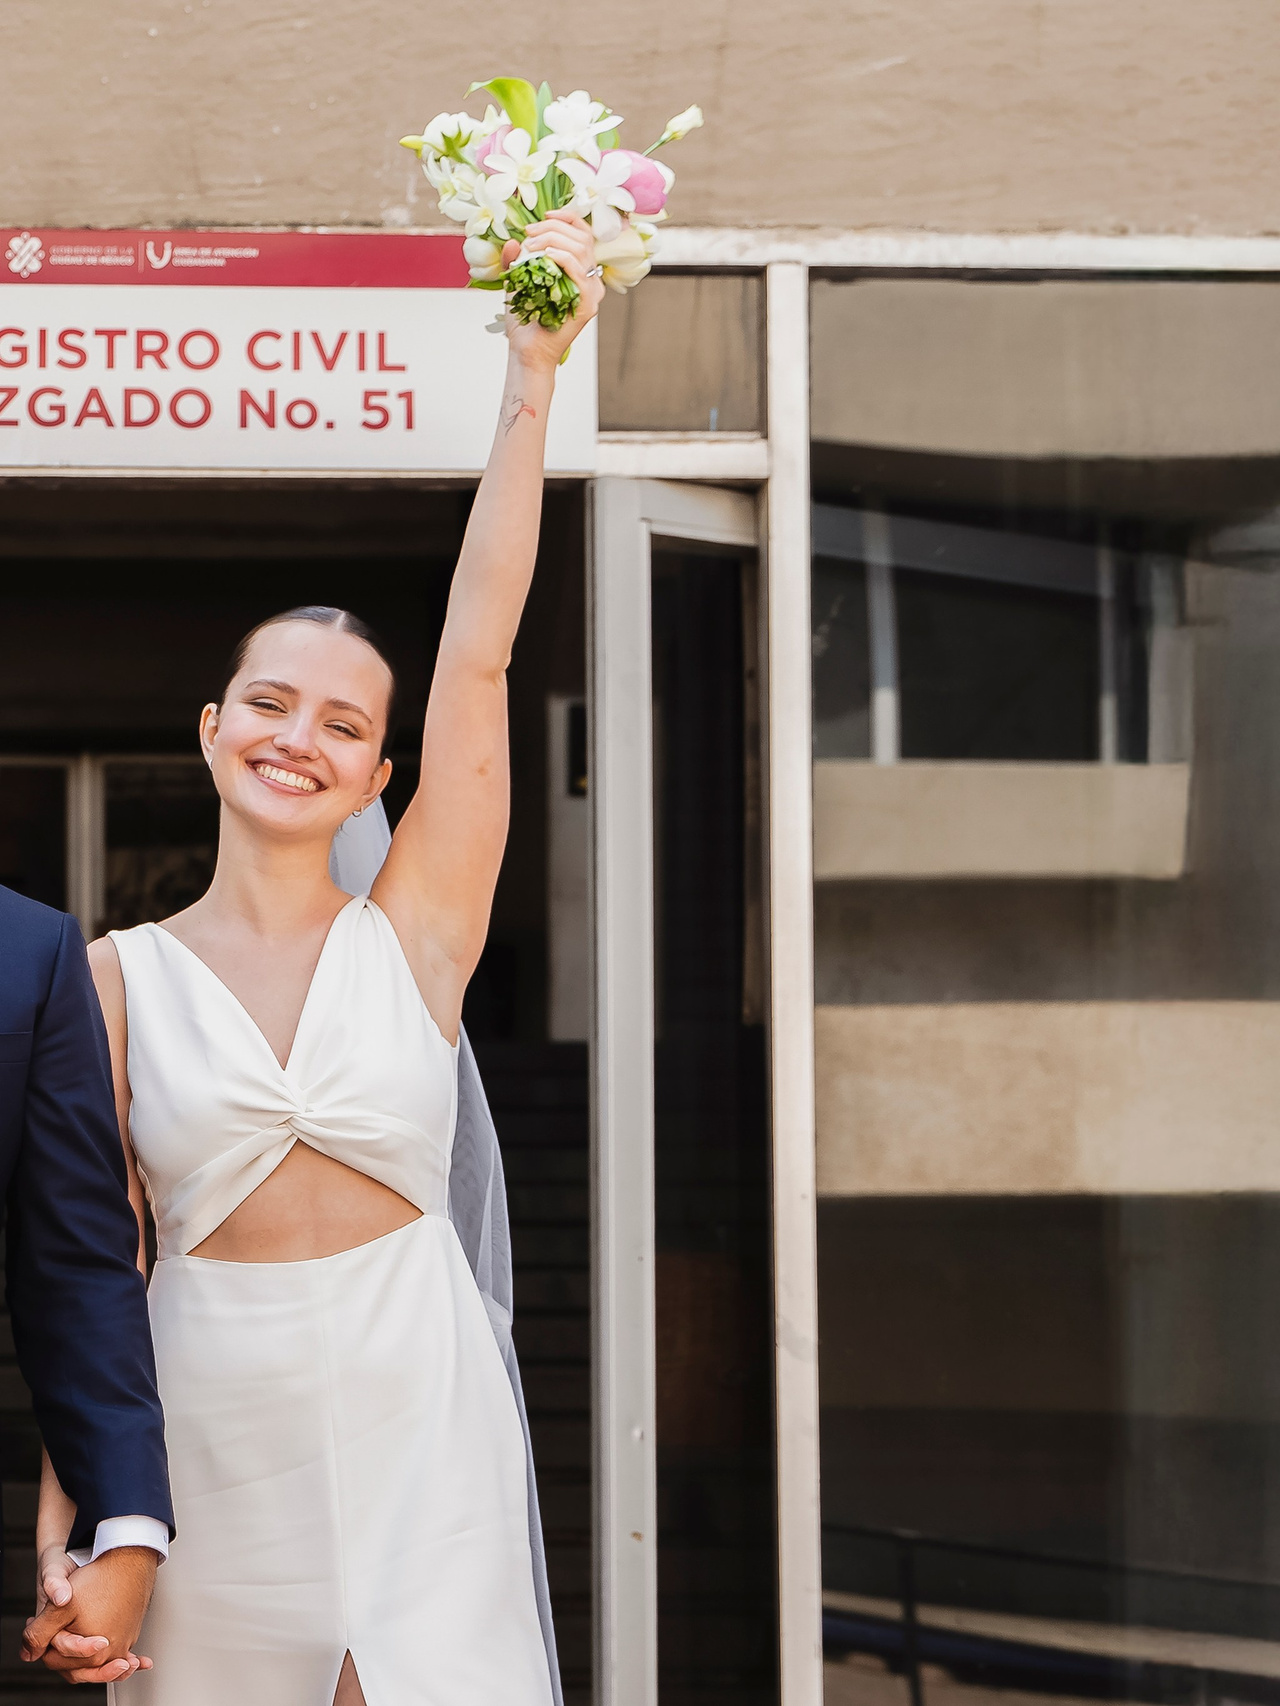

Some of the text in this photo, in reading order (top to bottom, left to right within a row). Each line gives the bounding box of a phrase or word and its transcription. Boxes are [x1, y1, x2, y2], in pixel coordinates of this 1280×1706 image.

[246, 330, 406, 372] CIVIL
[239, 389, 335, 430] No.
[361, 390, 415, 431] 51
